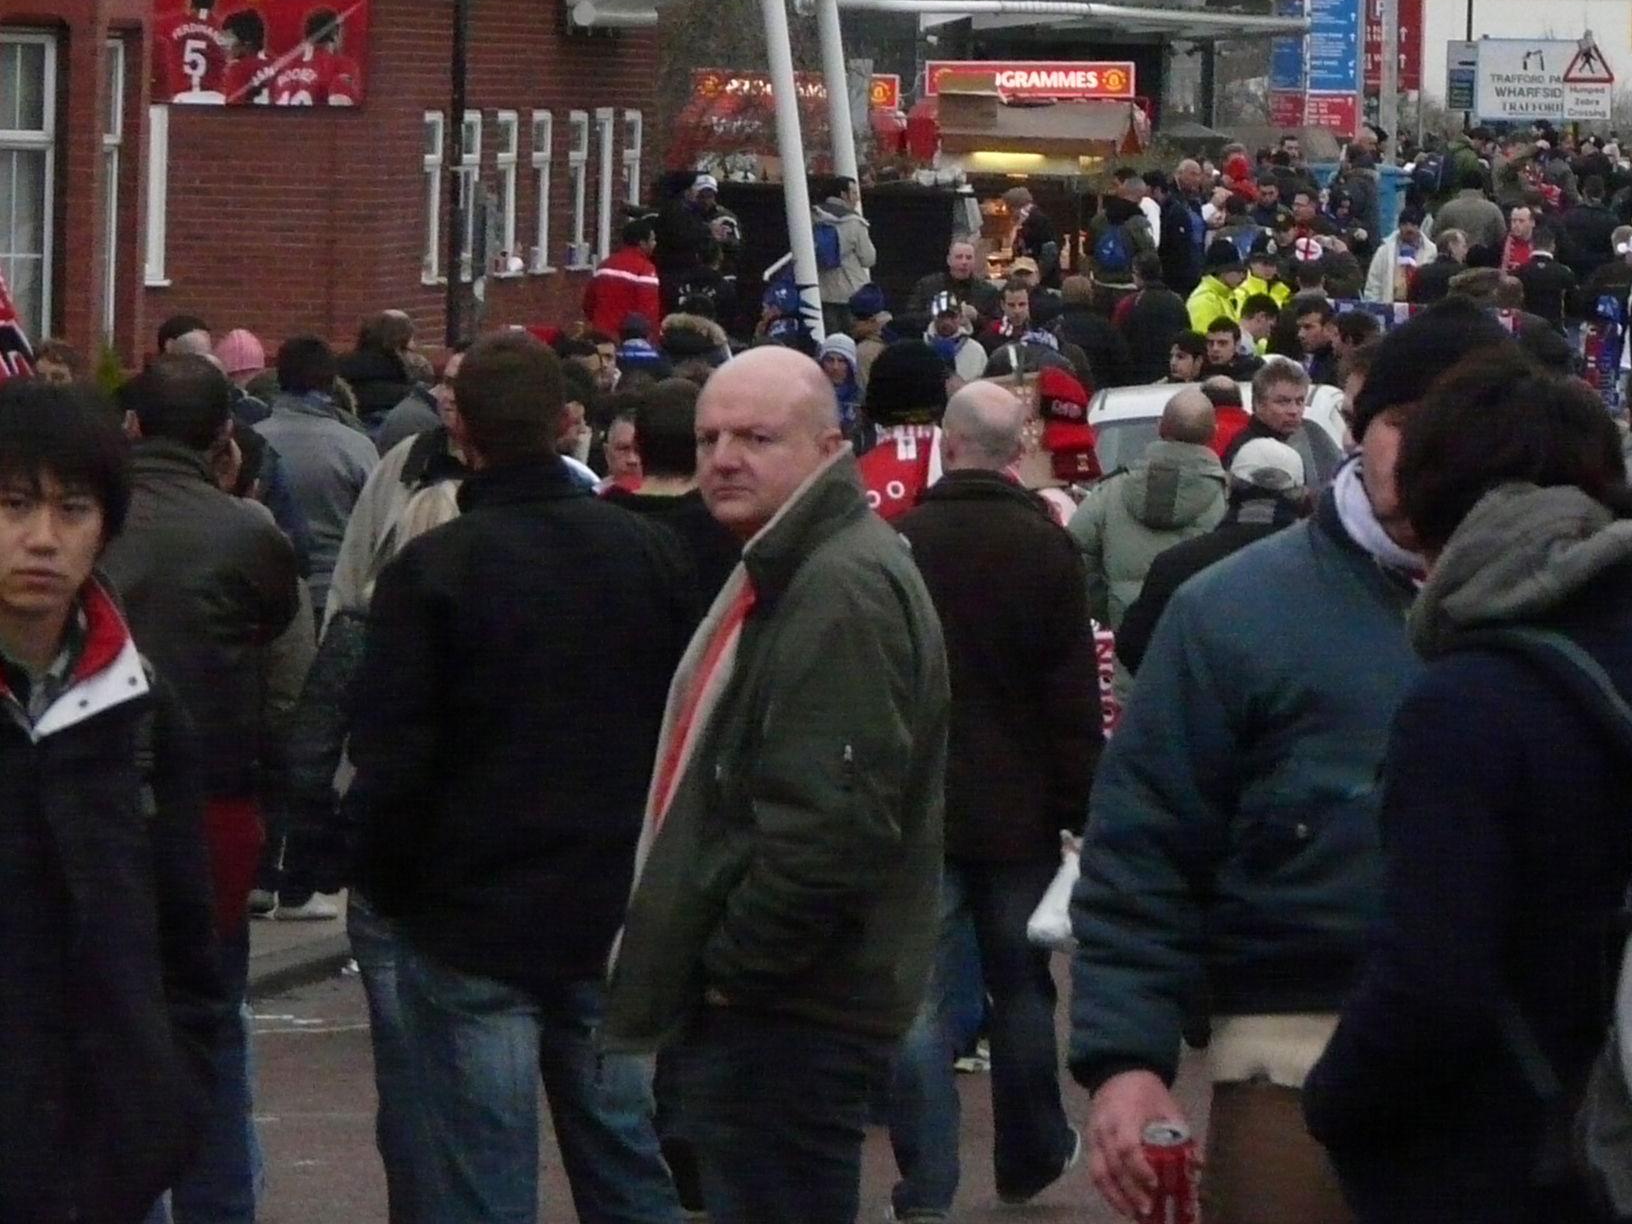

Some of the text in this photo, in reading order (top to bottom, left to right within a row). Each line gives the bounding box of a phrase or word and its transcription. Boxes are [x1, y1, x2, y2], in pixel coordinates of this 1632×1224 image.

[183, 39, 208, 77] 5
[995, 70, 1098, 89] GRAMMES
[1490, 74, 1545, 84] TRAFFORD
[1494, 87, 1562, 98] WHARFSID
[1567, 108, 1607, 118] Crossing
